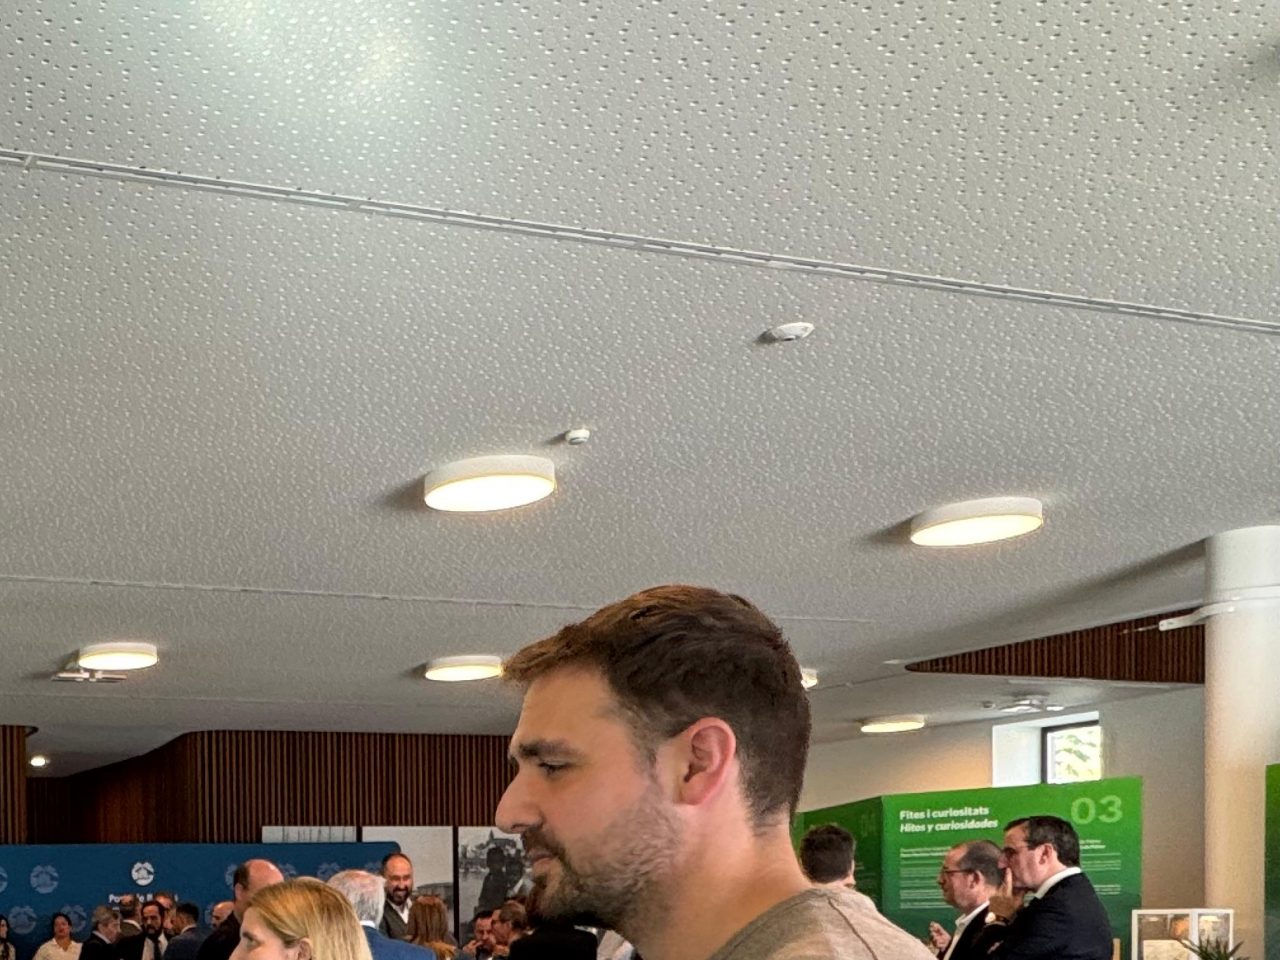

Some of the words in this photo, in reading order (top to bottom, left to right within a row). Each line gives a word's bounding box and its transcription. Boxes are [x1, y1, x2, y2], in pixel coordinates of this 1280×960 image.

[899, 809, 926, 820] Fites
[932, 806, 989, 818] curiositats
[1070, 796, 1123, 824] 03
[900, 822, 926, 833] Hitos
[927, 823, 932, 833] y
[935, 818, 998, 830] curiosidades
